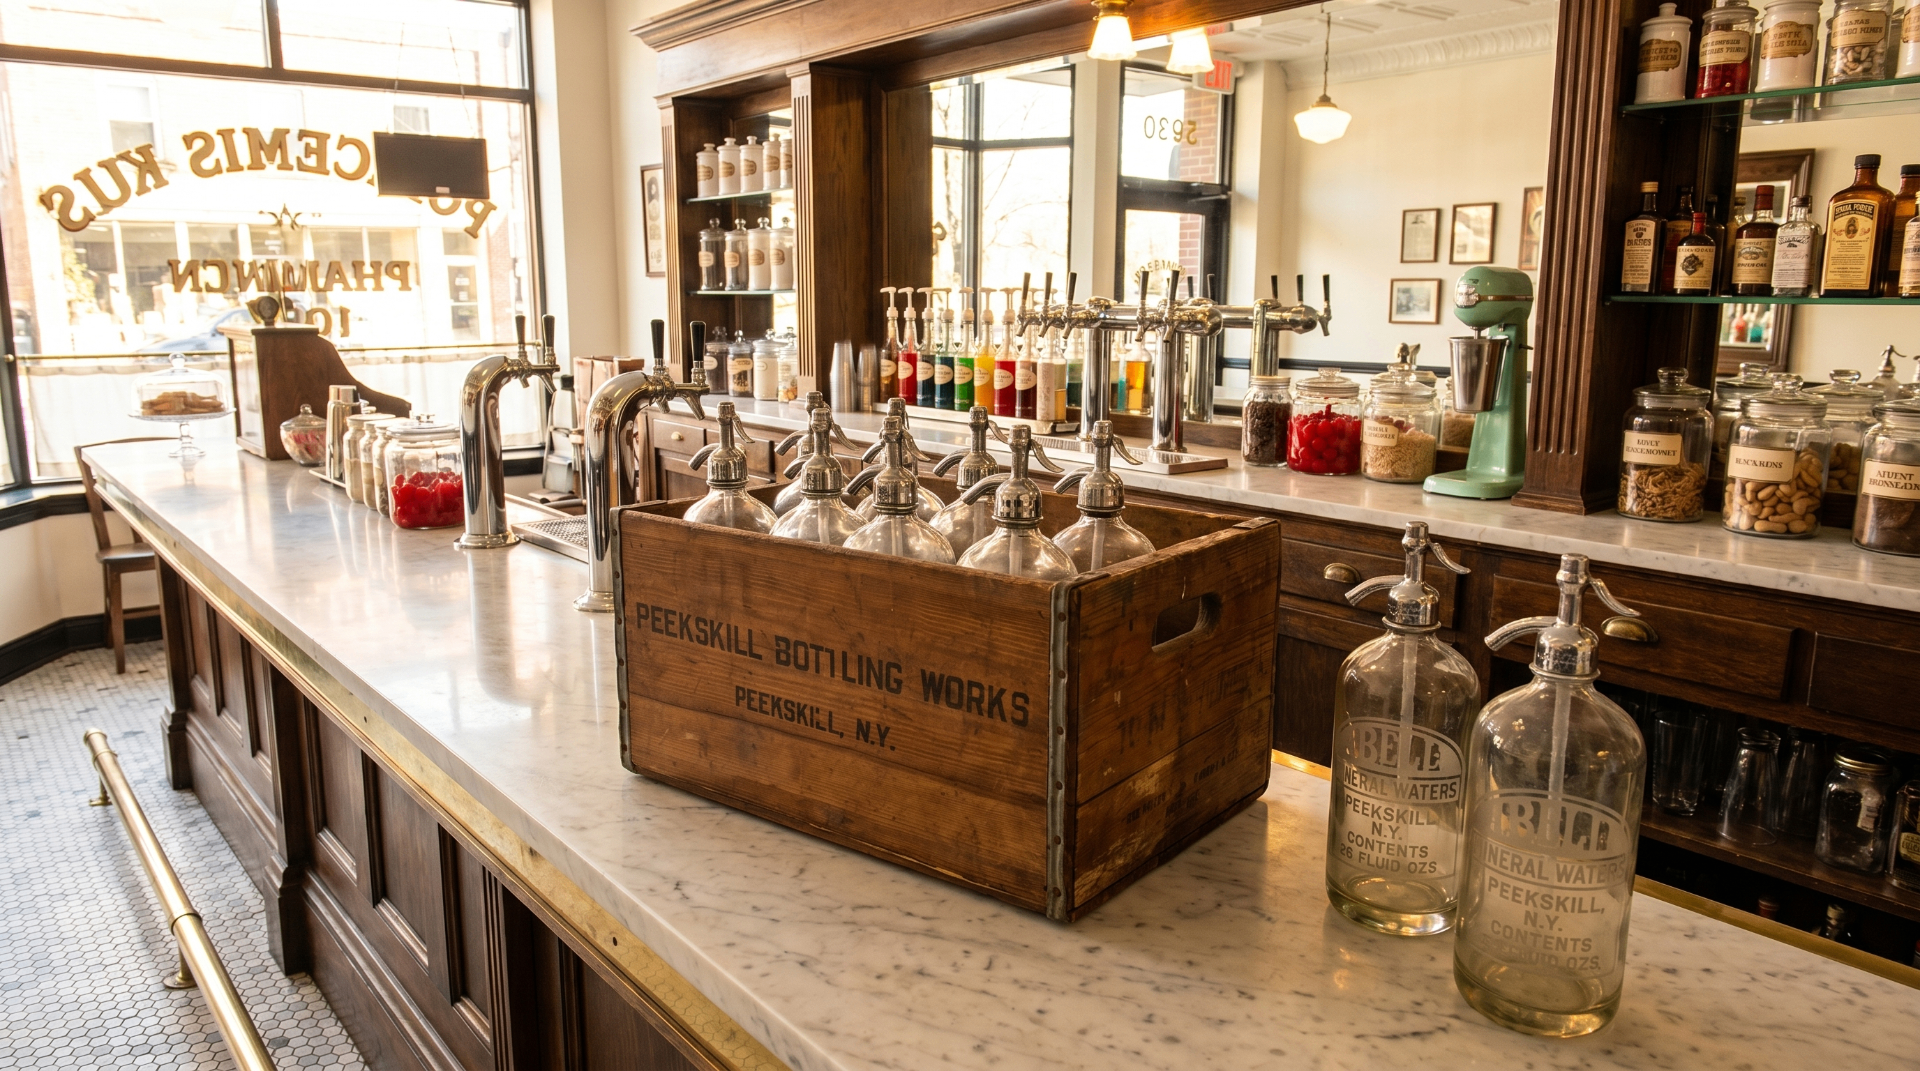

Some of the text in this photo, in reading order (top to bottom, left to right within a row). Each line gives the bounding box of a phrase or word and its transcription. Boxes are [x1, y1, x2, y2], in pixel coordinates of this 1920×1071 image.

[636, 602, 763, 661] PEEKSKILL
[920, 668, 1031, 727] WORKS
[734, 685, 896, 751] PEEKSKILL, N.Y.
[1393, 782, 1457, 801] WATERS
[1347, 830, 1429, 859] CONTENTS
[1371, 821, 1403, 841] N.Y.
[1339, 843, 1438, 875] 26 FLUID OZS
[1556, 860, 1626, 886] WATERS
[1487, 877, 1606, 915] PEEKSKILL,
[1490, 919, 1593, 953] CONTENTS
[1523, 910, 1564, 932] N.Y.
